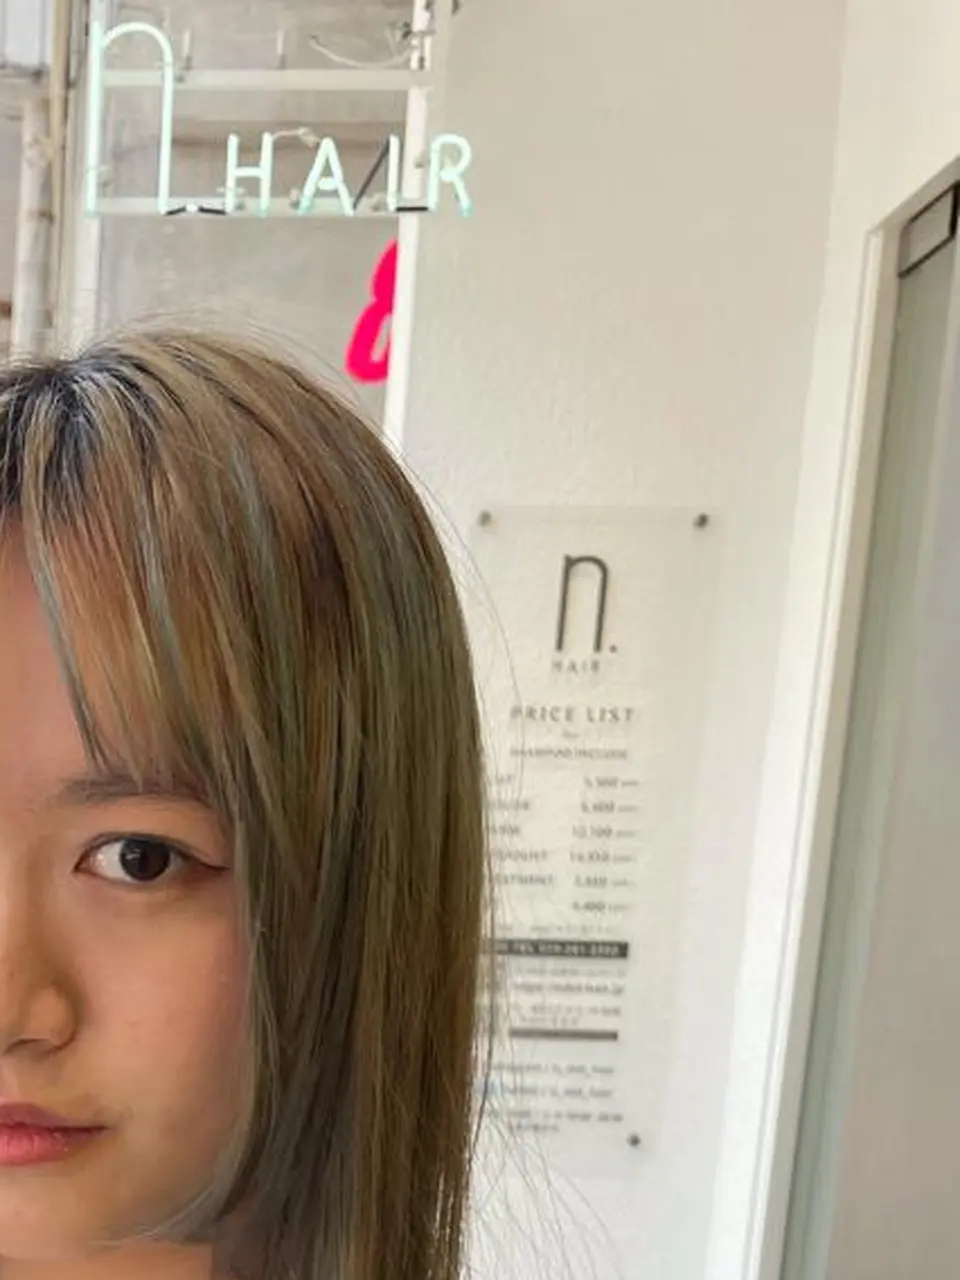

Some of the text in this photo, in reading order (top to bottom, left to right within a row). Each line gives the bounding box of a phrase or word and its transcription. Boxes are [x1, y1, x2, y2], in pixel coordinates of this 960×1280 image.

[223, 131, 474, 217] HAIR
[551, 659, 601, 674] HAIR
[509, 704, 635, 723] PRICE LIST
